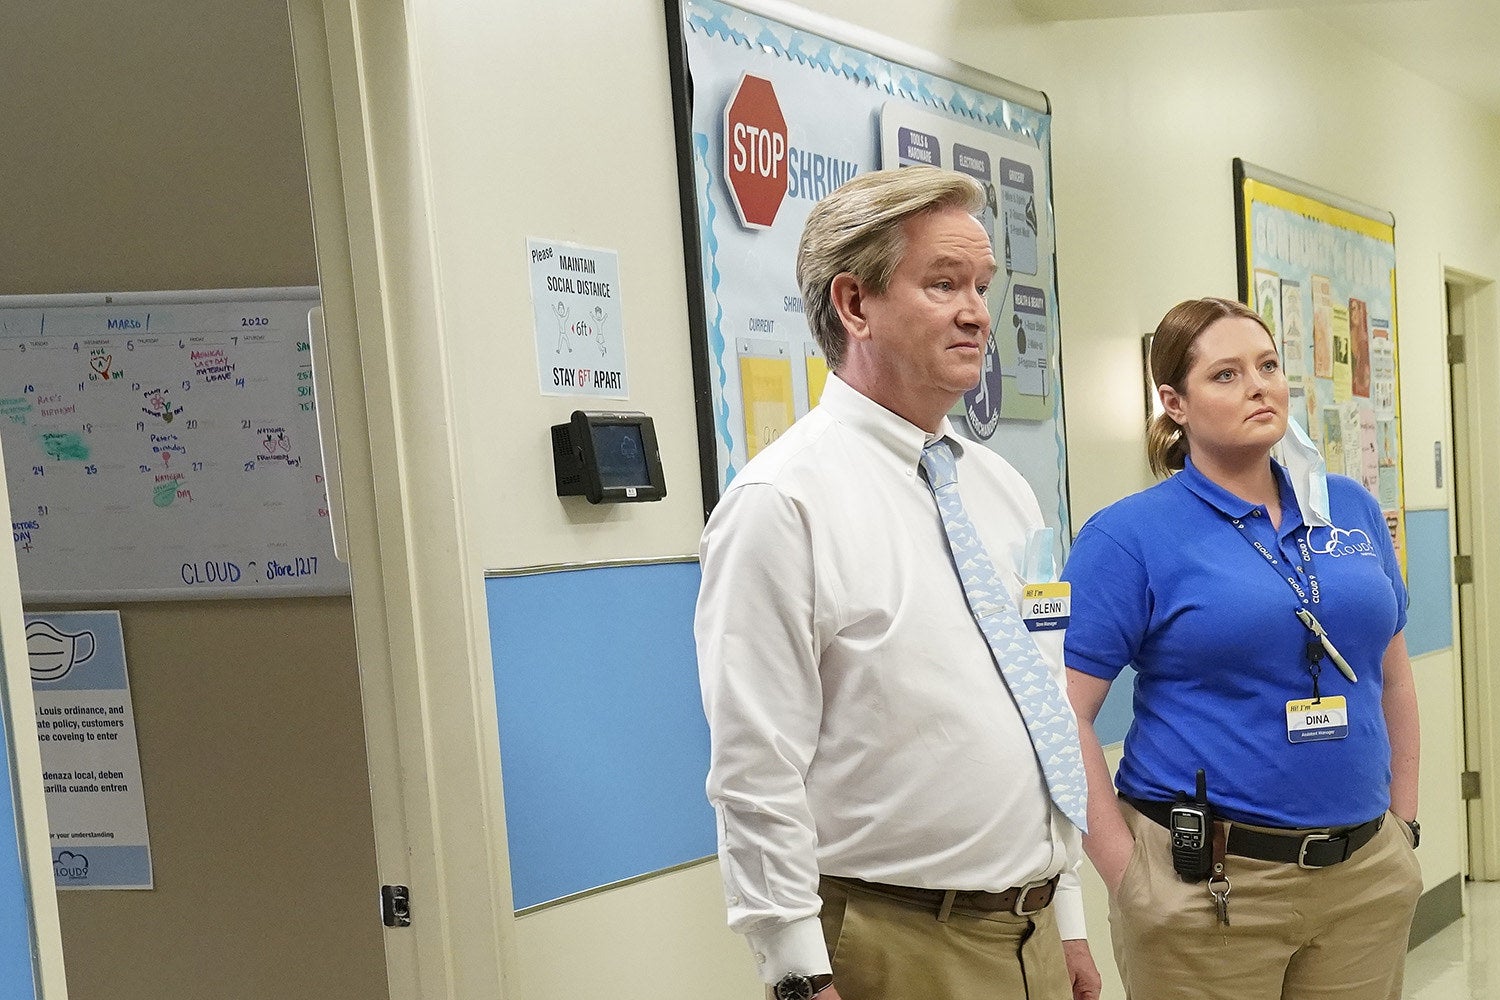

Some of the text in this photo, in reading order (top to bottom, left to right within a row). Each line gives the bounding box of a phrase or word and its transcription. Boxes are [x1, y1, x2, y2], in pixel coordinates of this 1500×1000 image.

[910, 132, 924, 146] TOOLS
[734, 122, 785, 179] STOP
[907, 145, 932, 164] HARDWARE
[959, 154, 986, 173] ELECTRONICS
[531, 247, 554, 264] Please
[559, 255, 596, 274] MAINTAIN
[546, 276, 611, 298] SOCIAL DISTANCE
[241, 317, 269, 327] 2020
[576, 320, 588, 336] 6ft
[749, 317, 775, 333] CURRENT
[230, 336, 239, 346] 7
[72, 342, 80, 353] 4
[196, 362, 236, 375] MATERNITY
[205, 372, 232, 383] LEAVE
[235, 377, 246, 389] 14
[553, 367, 621, 389] STAY 6FT APART
[23, 384, 35, 394] 10
[136, 420, 145, 433] 19
[186, 419, 198, 430] 20
[241, 419, 251, 430] 21
[32, 465, 45, 477] 24
[84, 464, 98, 476] 25
[139, 464, 151, 473] 26
[191, 462, 203, 472] 27
[13, 531, 32, 544] DAY
[1253, 541, 1273, 560] CLOUD
[181, 560, 241, 585] CLOUD
[266, 562, 295, 581] Store
[1287, 577, 1305, 598] CLOUD
[1032, 602, 1062, 615] GLENN
[39, 706, 124, 717] Louis ordinance, and
[1300, 704, 1311, 712] I'm
[37, 720, 124, 730] ate policy, customers
[1306, 714, 1330, 726] DINA
[52, 732, 85, 743] coveing
[86, 732, 95, 741] to
[97, 731, 118, 741] enter
[42, 770, 124, 781] denaza local, deben
[44, 783, 128, 793] arilla cuando entren
[56, 832, 70, 840] your
[71, 831, 115, 840] understanding
[54, 866, 89, 878] LOUD9
